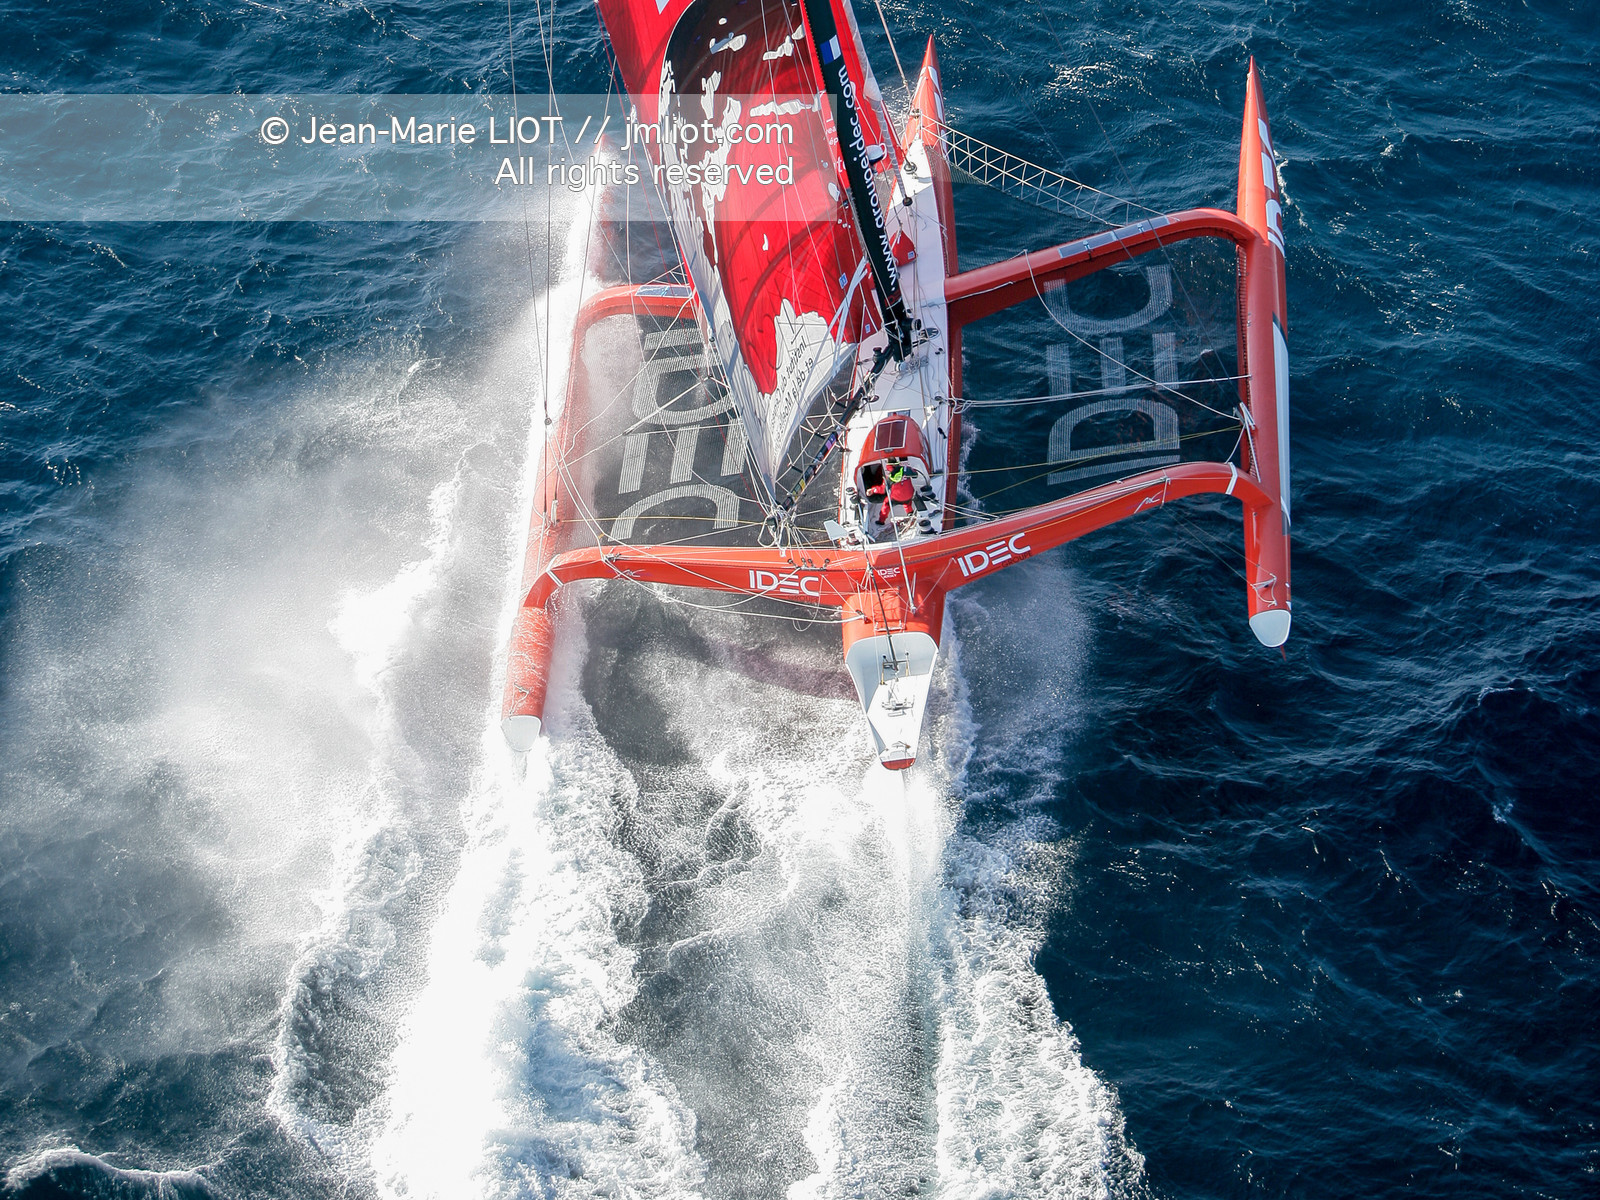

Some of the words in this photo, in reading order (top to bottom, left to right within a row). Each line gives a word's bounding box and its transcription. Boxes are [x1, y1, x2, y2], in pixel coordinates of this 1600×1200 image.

[608, 327, 749, 542] IDEC
[1043, 265, 1181, 486] IDEC
[748, 569, 820, 597] IDEC
[957, 532, 1032, 577] IDEC
